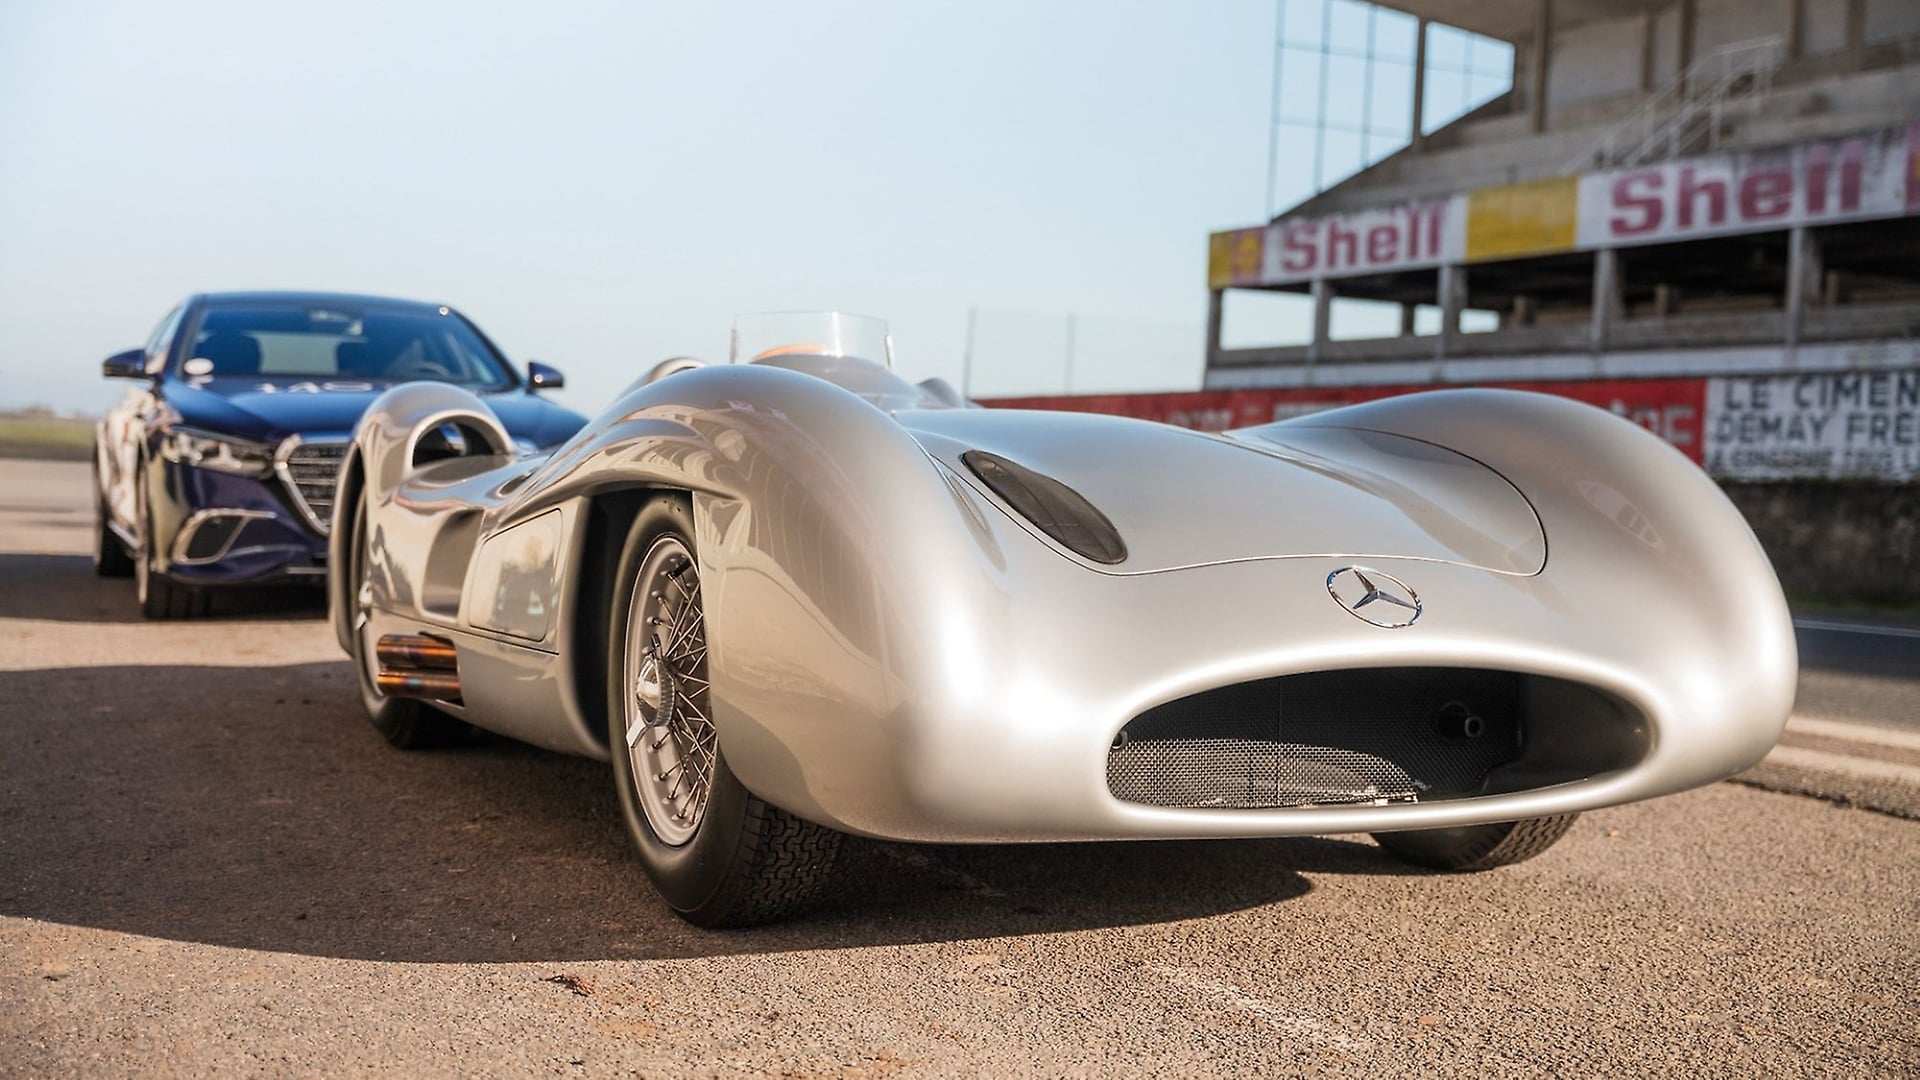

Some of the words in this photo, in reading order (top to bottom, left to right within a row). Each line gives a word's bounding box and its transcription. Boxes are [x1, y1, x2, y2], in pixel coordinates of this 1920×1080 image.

[1609, 140, 1863, 238] Shell
[1283, 203, 1443, 273] Shell
[1724, 376, 1771, 410] LE
[1713, 412, 1829, 445] DEMAY
